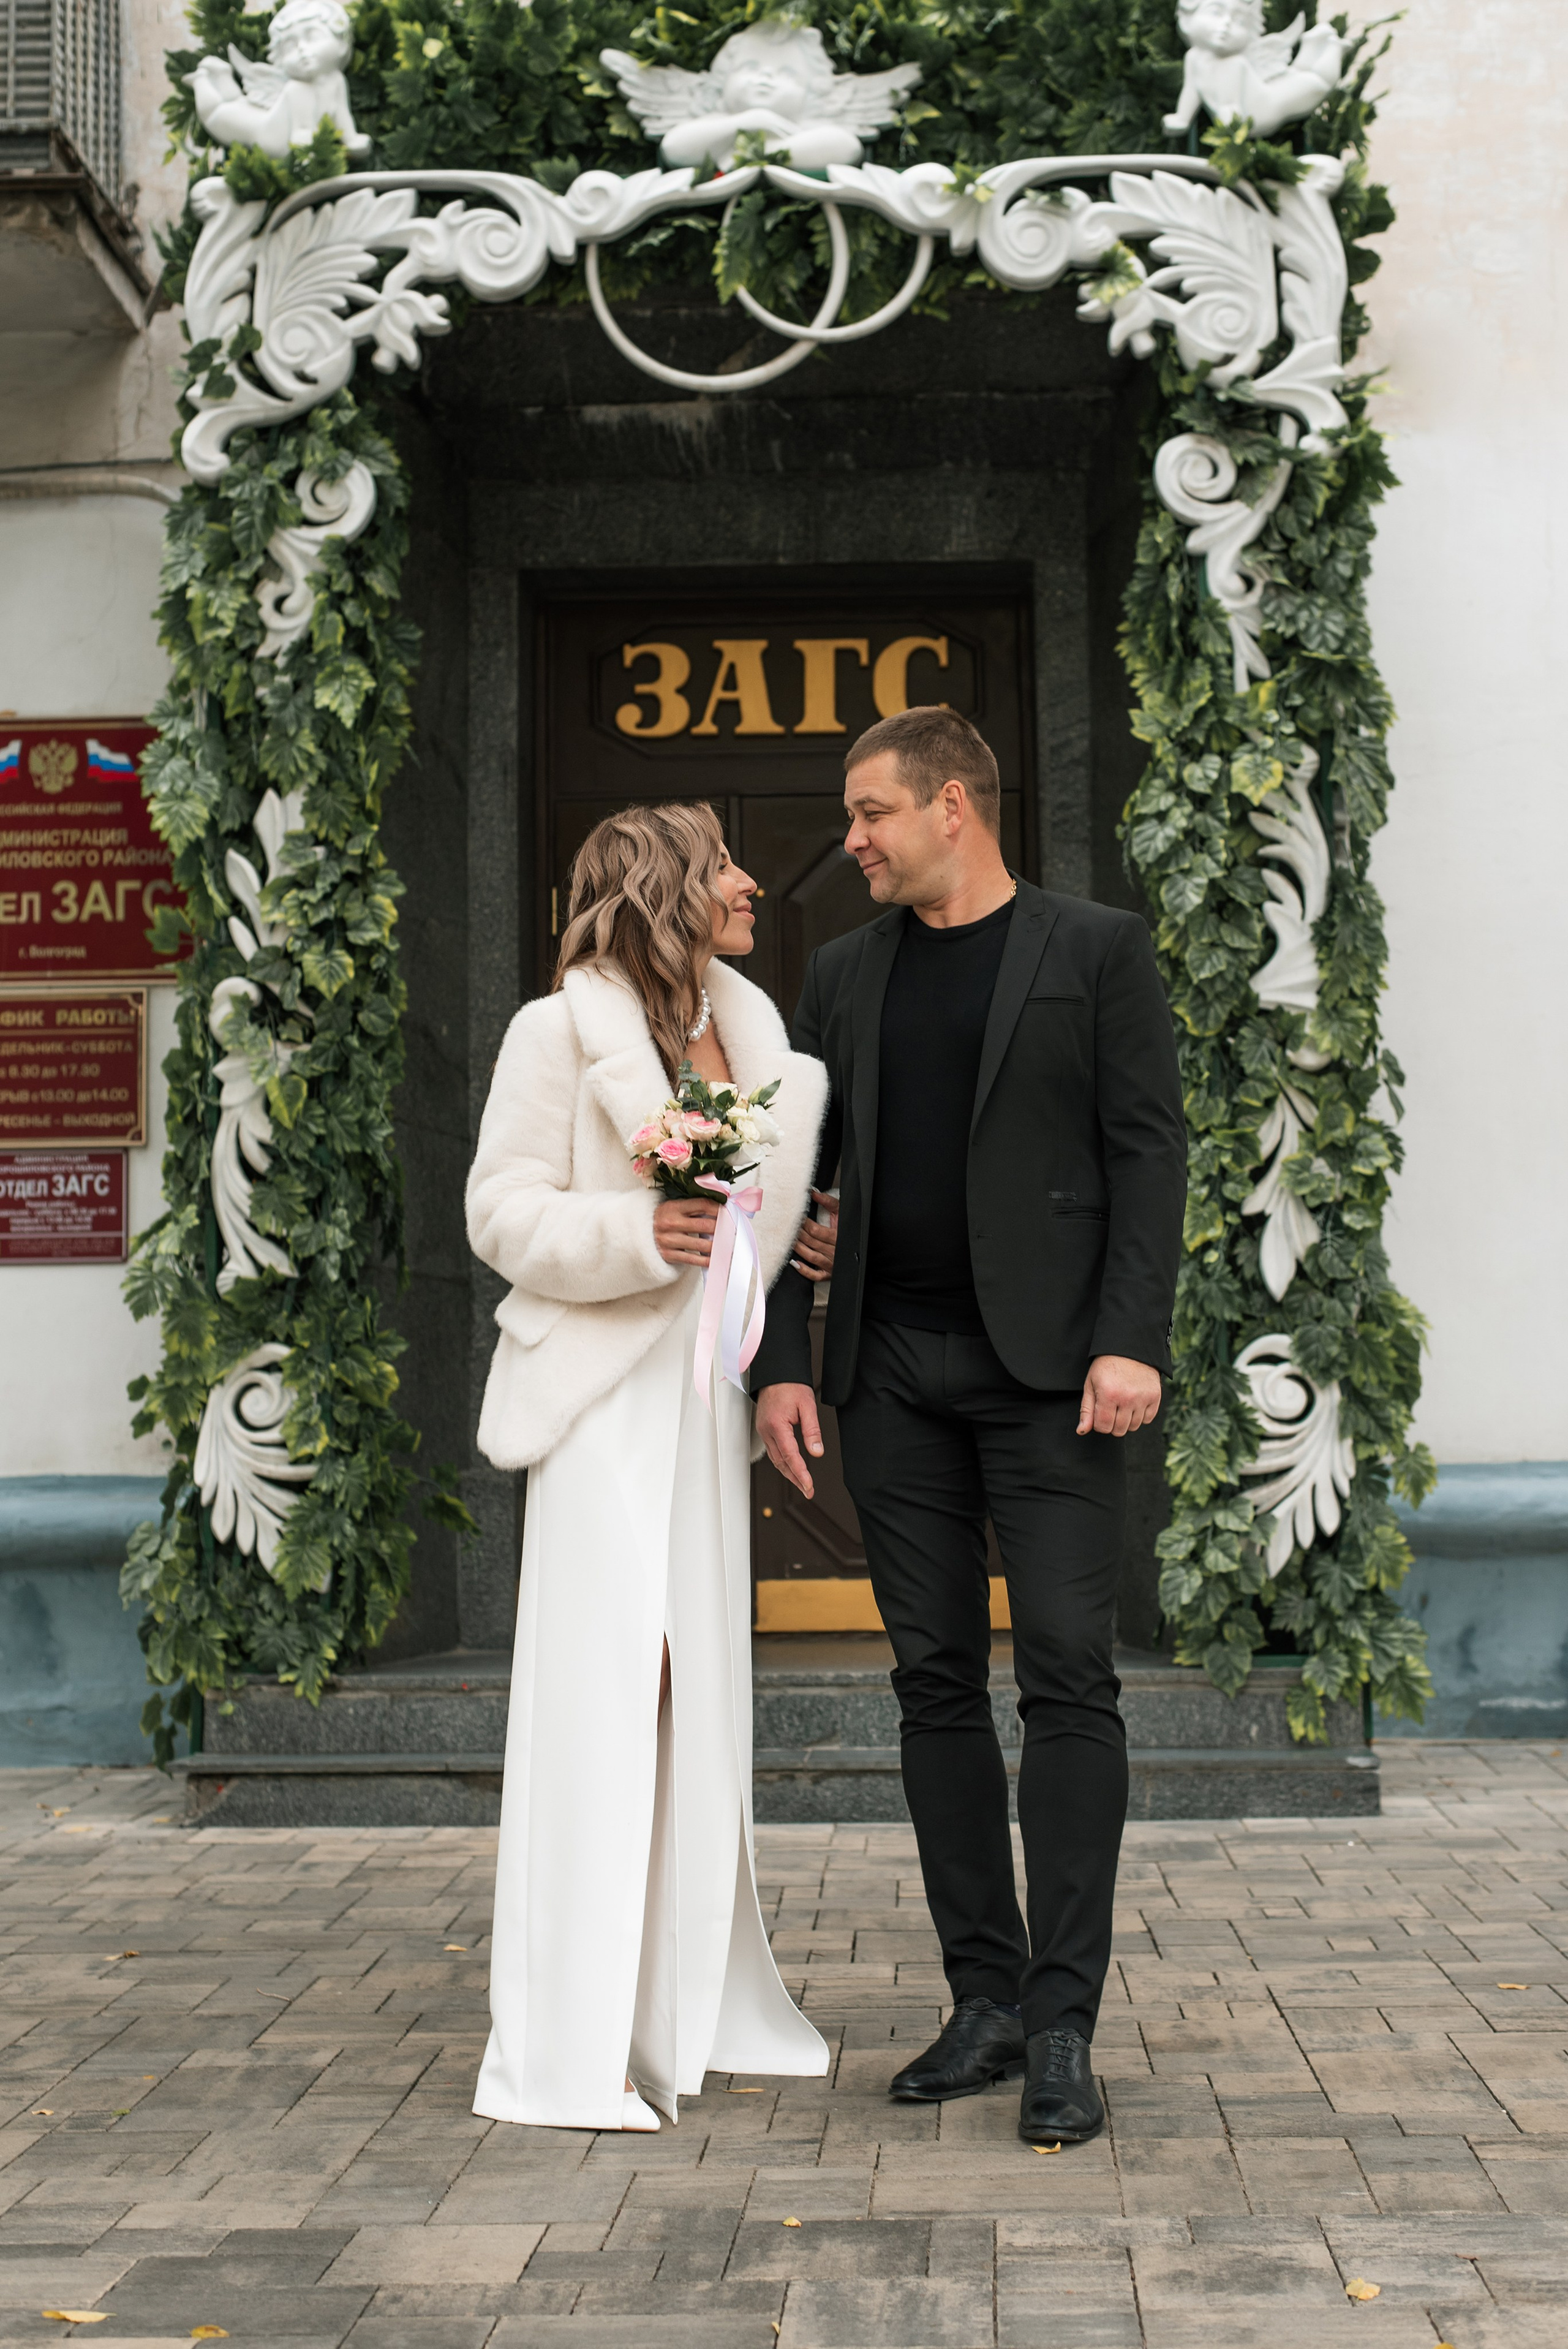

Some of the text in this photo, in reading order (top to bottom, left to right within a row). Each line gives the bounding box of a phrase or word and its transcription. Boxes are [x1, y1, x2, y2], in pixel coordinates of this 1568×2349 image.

[615, 636, 949, 736] ЗАГС
[0, 828, 128, 848] МИНИСТРАЦИЯ
[51, 879, 173, 923] ЗАГС
[56, 1008, 134, 1026] РАБОТЫ
[51, 1173, 110, 1197] ЗАГС
